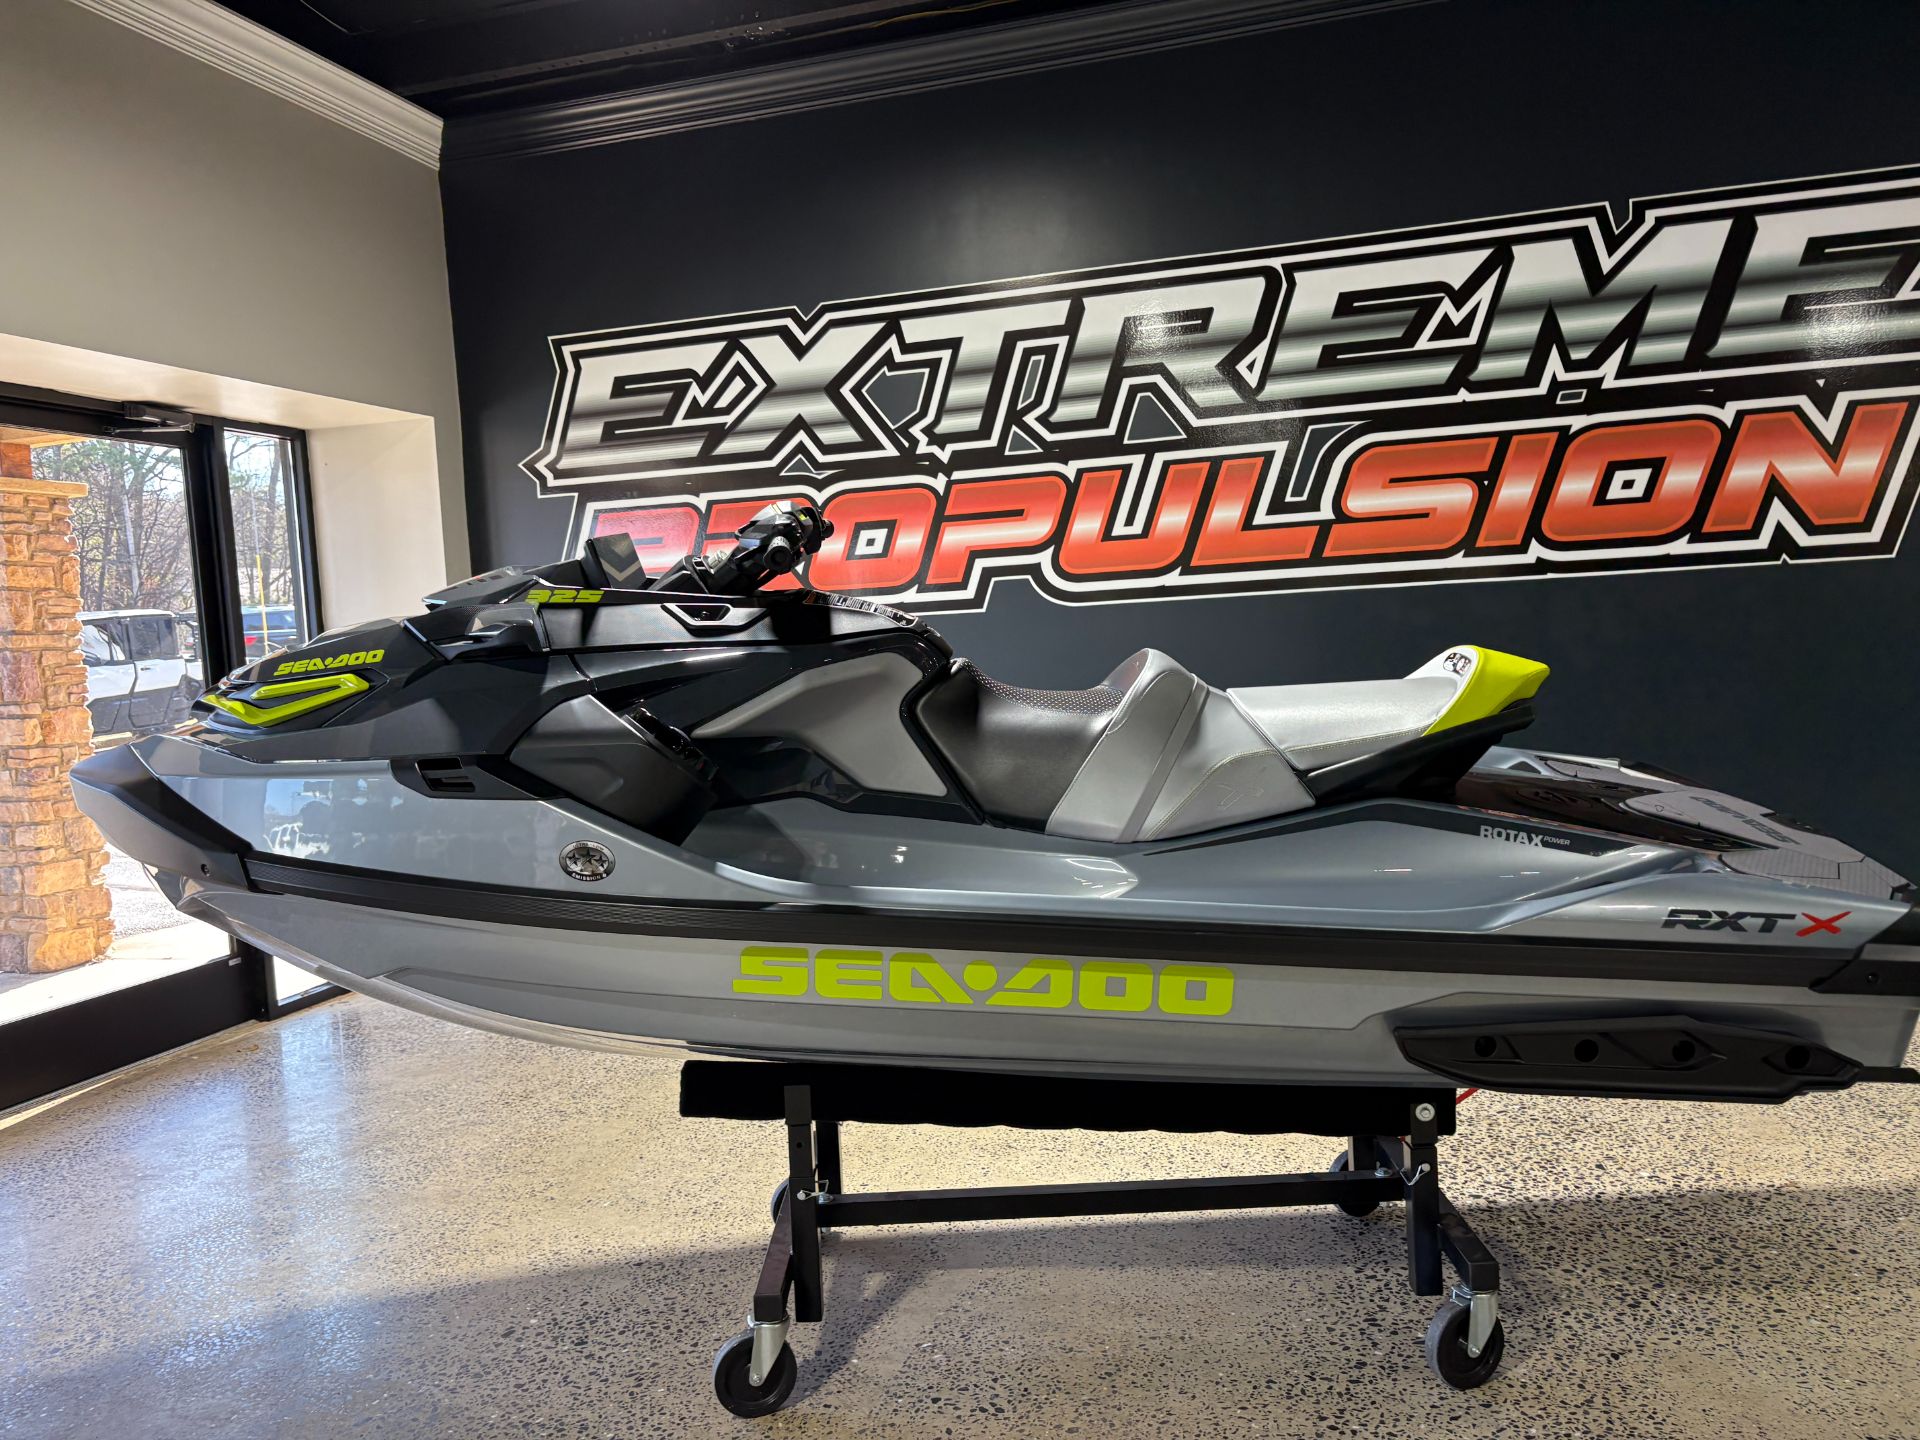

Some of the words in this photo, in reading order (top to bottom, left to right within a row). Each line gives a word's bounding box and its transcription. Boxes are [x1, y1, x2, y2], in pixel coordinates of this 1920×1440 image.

[554, 196, 1920, 470] EXTREME
[525, 589, 605, 604] 325
[1480, 825, 1544, 848] ROTAX
[1543, 835, 1570, 846] POWER
[1661, 908, 1797, 933] RXT
[1795, 911, 1852, 937] X
